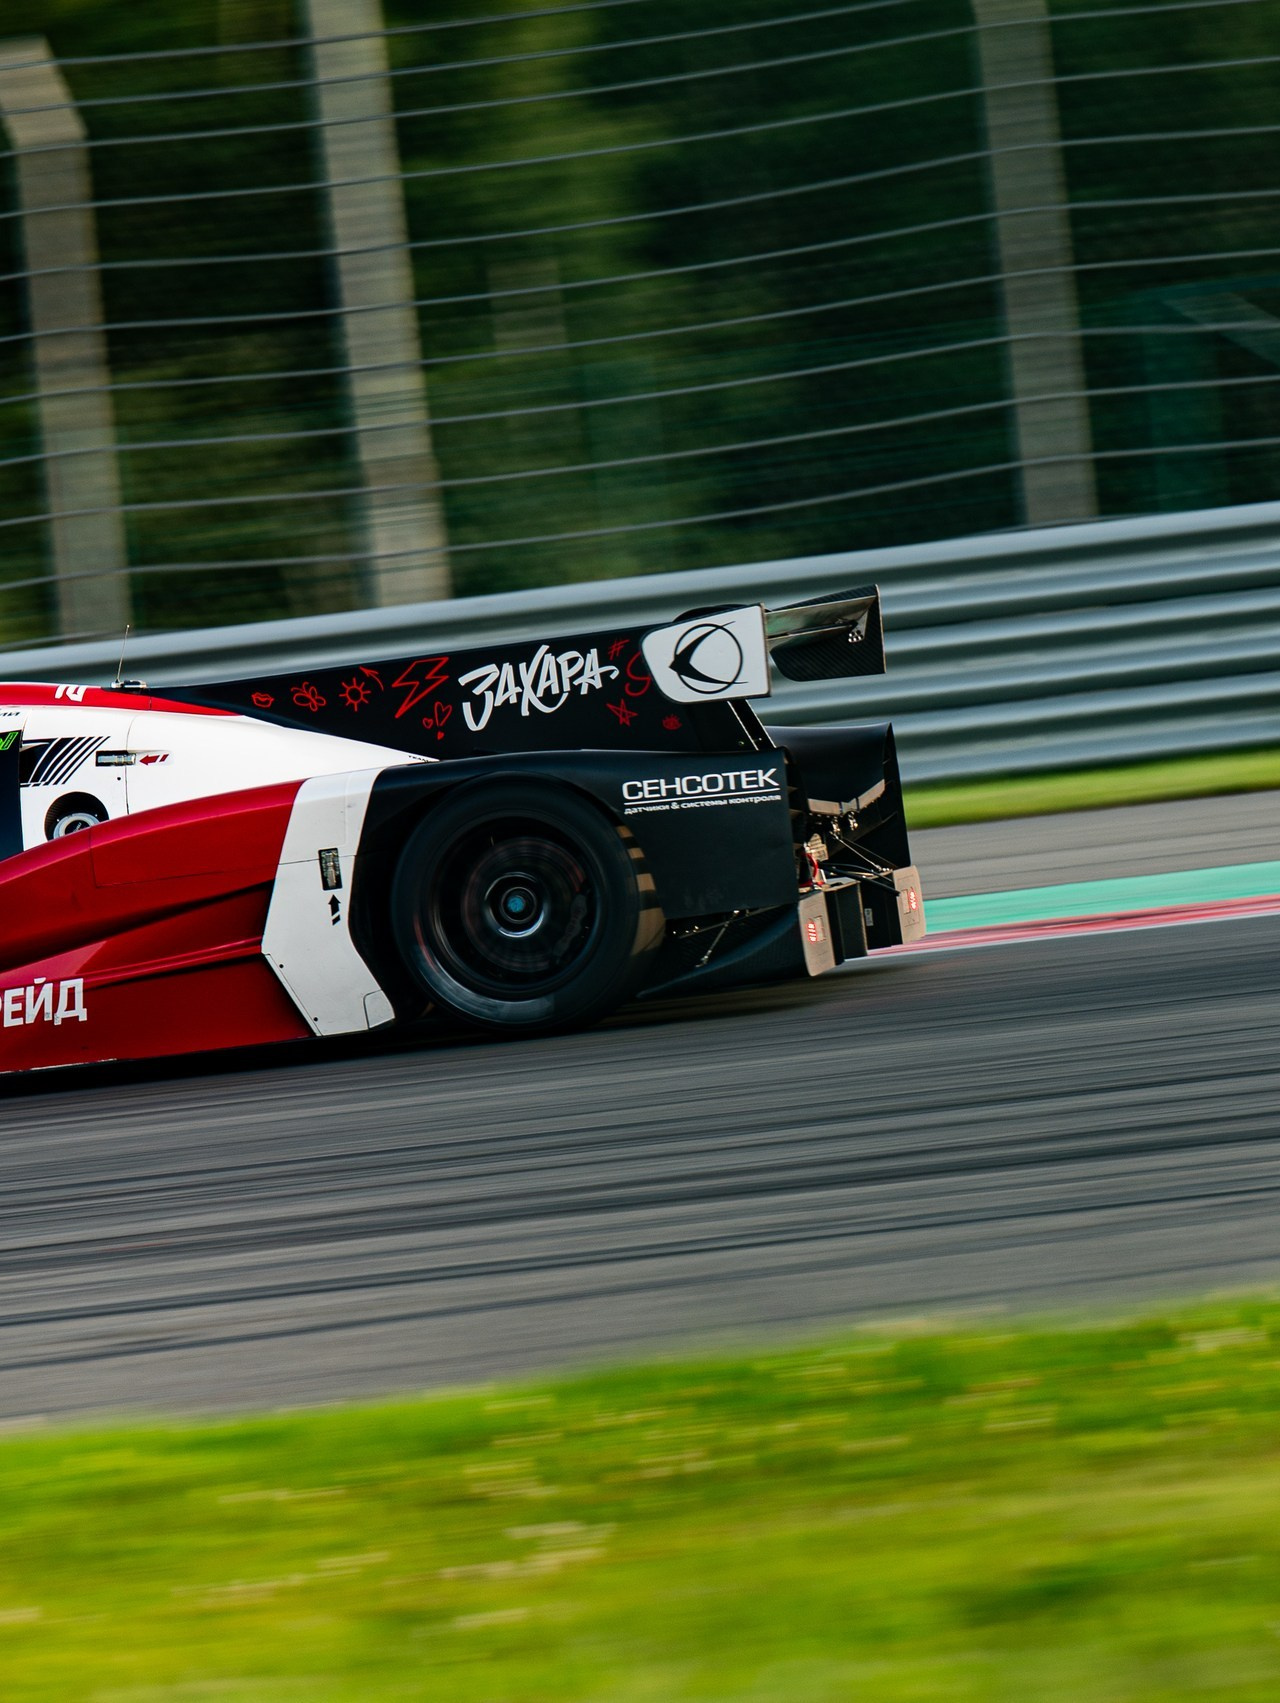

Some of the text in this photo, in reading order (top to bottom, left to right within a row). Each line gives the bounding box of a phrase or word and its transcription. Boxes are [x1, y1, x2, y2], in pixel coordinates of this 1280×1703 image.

[458, 644, 620, 731] ЗАХАРА
[622, 767, 780, 800] СЕНСОТЕК
[671, 802, 680, 810] &
[681, 799, 728, 809] системы
